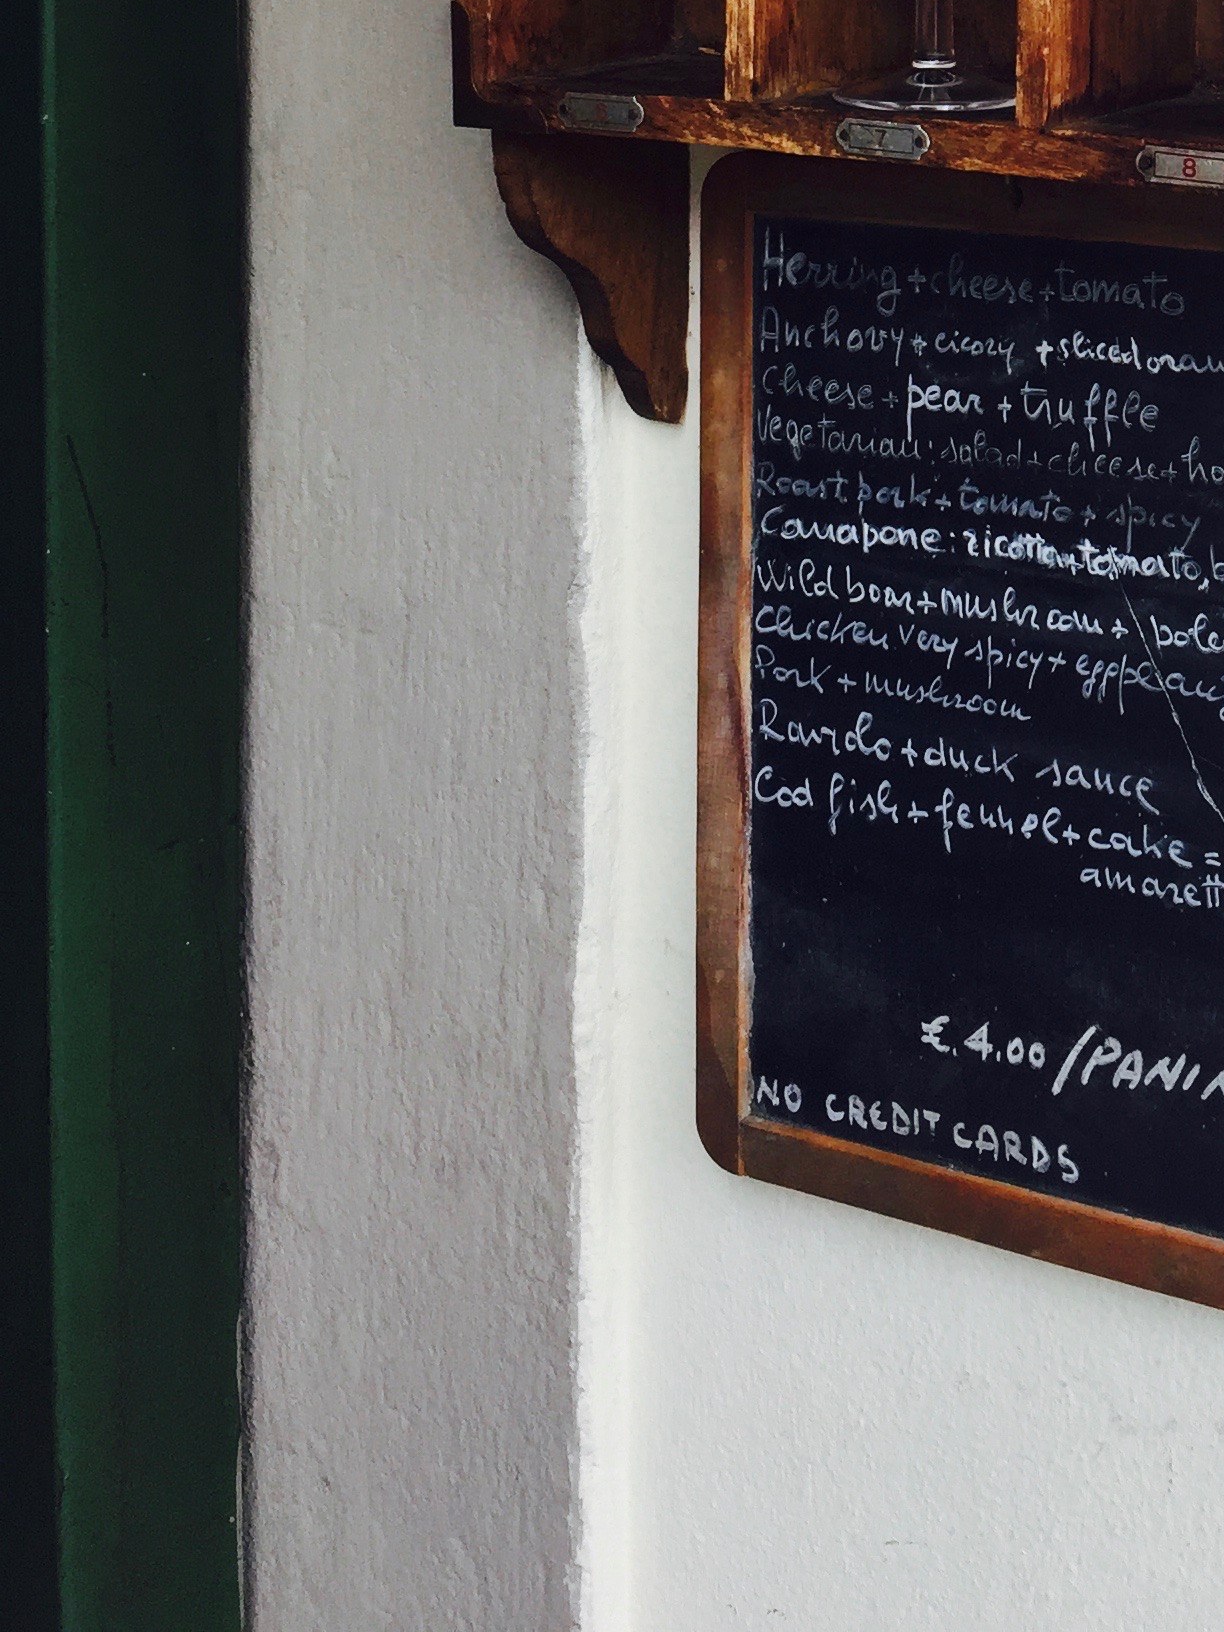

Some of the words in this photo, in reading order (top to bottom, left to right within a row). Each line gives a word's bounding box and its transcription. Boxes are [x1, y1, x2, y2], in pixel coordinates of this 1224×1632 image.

[875, 128, 887, 148] 7
[1182, 157, 1197, 178] 8
[756, 558, 839, 599] Wild
[754, 765, 814, 807] Cod
[756, 1075, 801, 1113] NO
[824, 1092, 942, 1137] CREDIT
[952, 1122, 1081, 1184] CARDS
